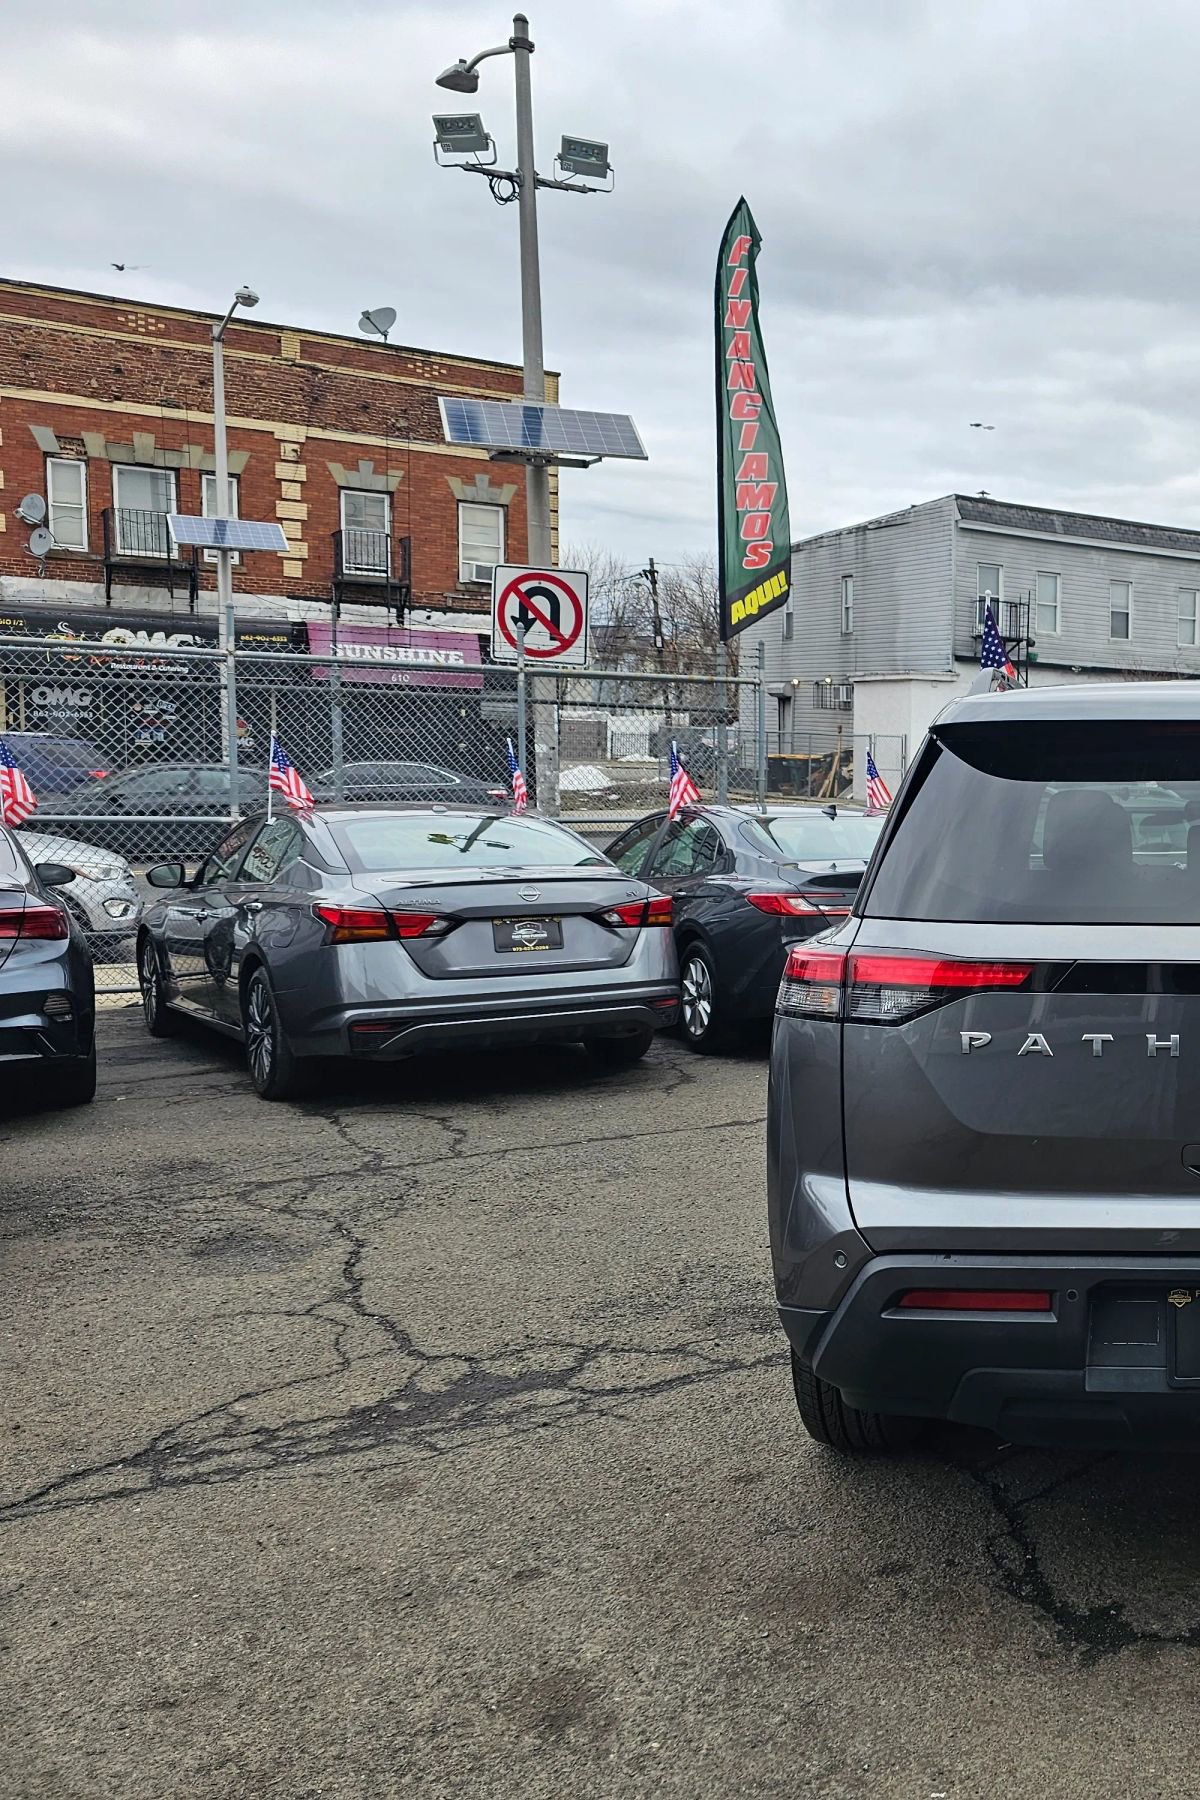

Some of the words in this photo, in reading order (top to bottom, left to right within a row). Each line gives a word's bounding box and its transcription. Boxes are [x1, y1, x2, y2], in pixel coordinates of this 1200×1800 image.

[723, 234, 779, 570] FINANCIAMOS
[731, 570, 788, 624] AQUI!
[330, 644, 464, 665] SUNSHINE
[32, 685, 92, 706] OMG
